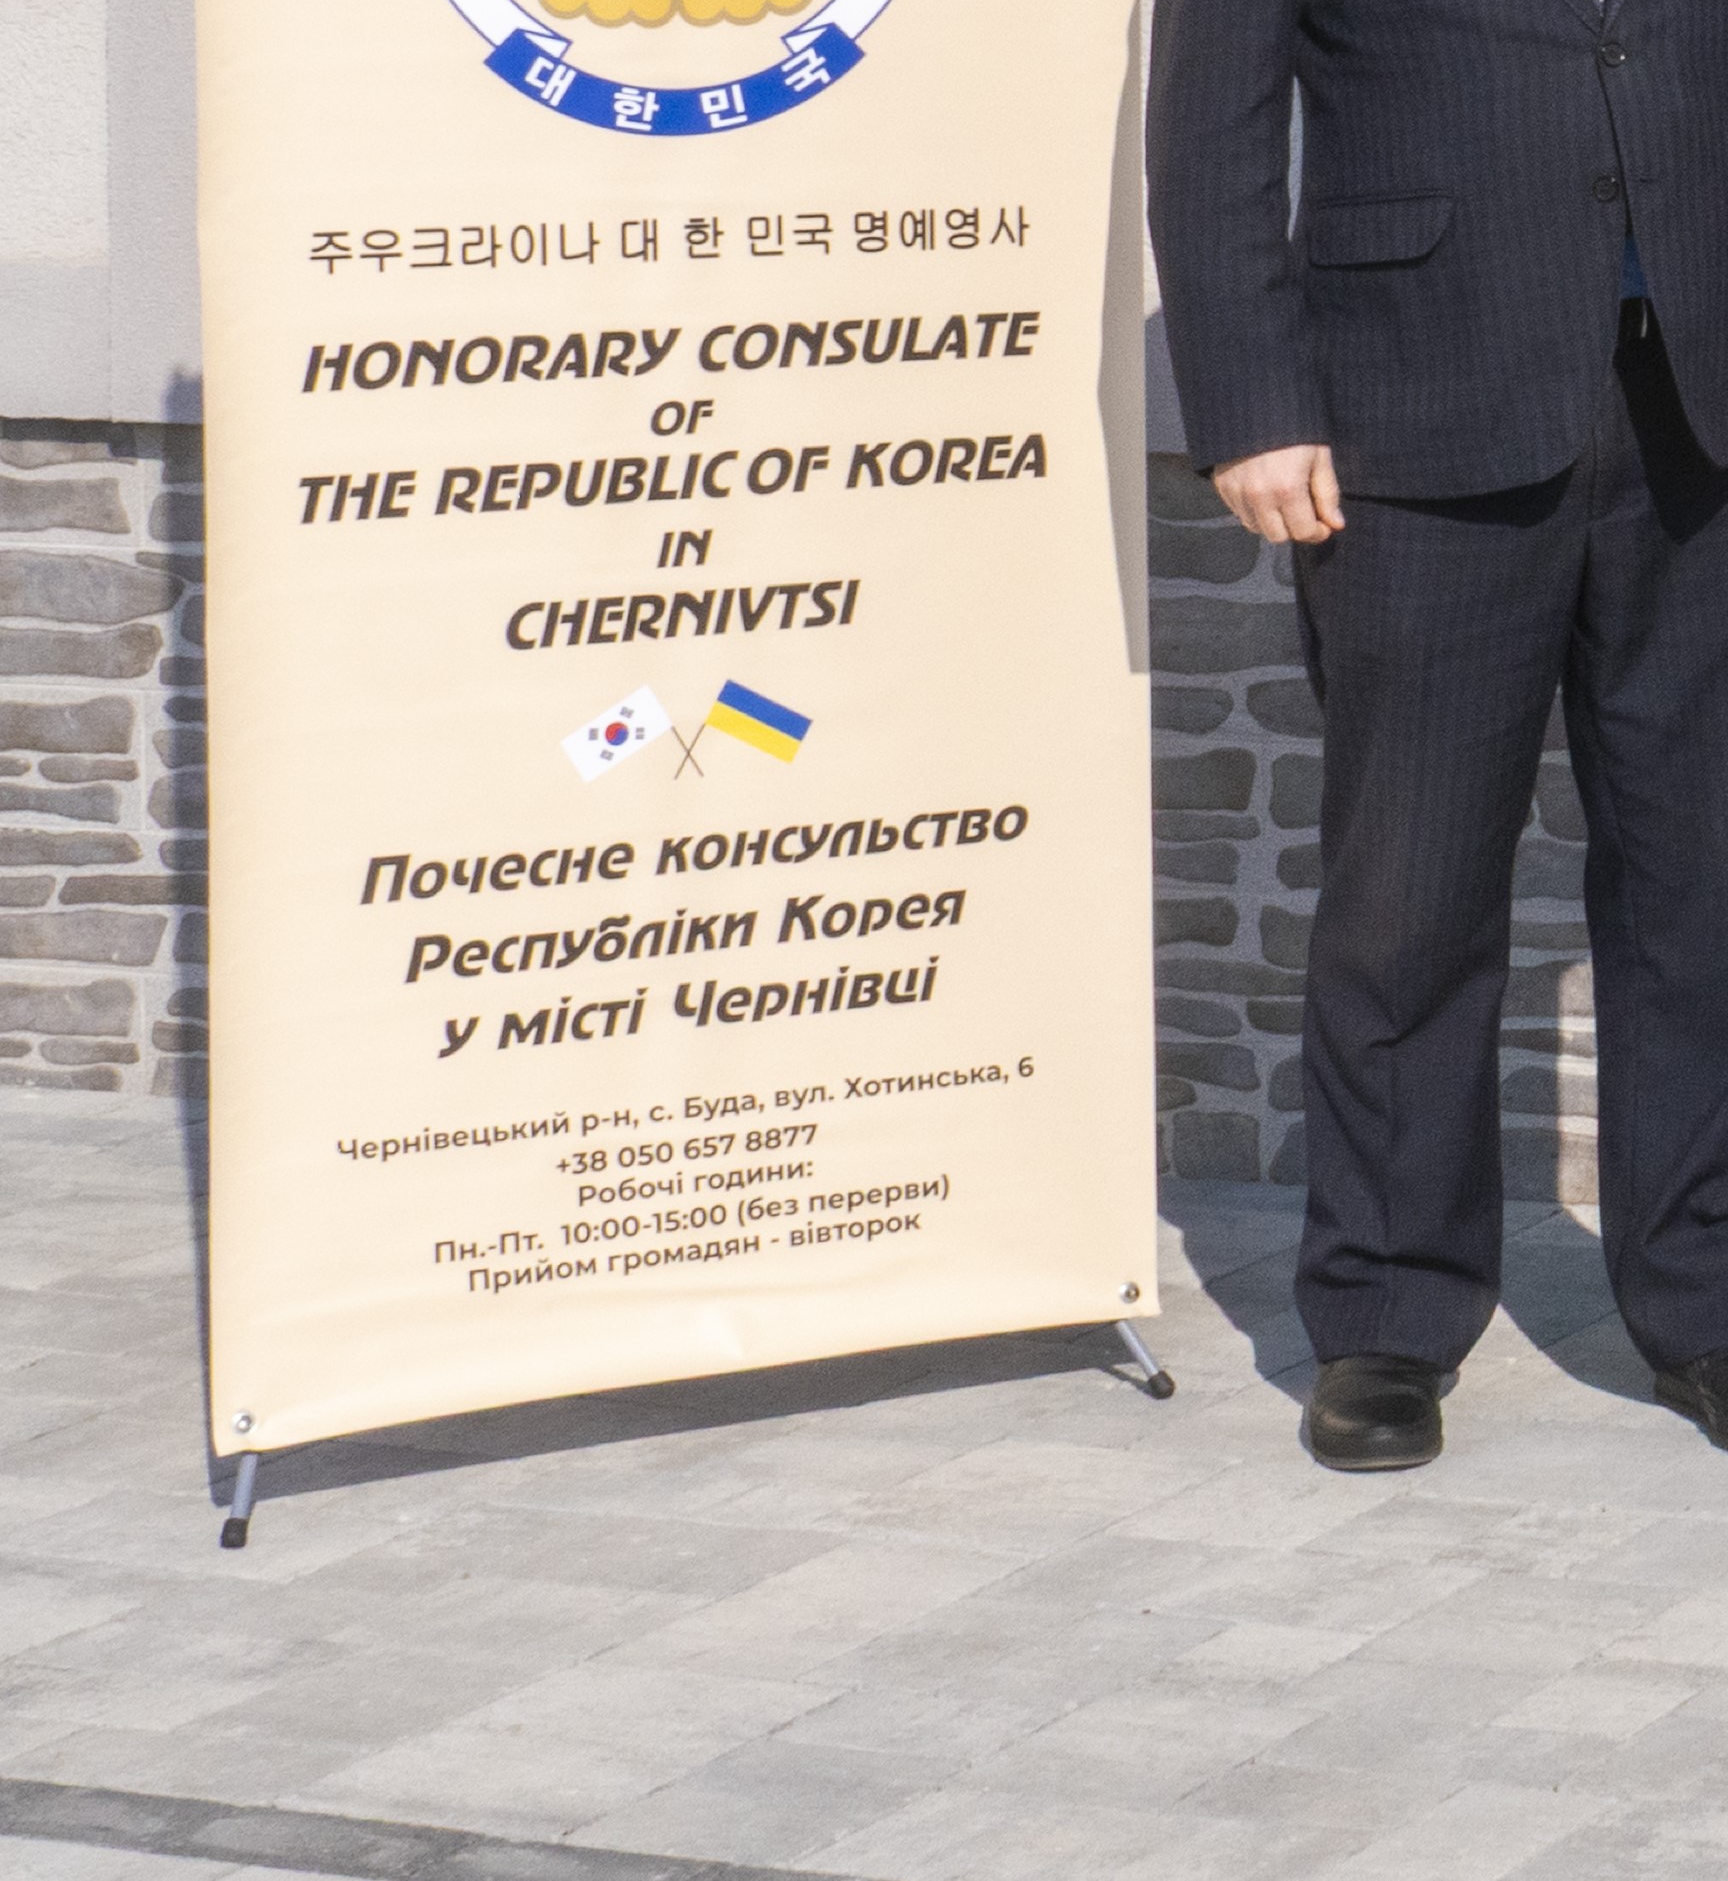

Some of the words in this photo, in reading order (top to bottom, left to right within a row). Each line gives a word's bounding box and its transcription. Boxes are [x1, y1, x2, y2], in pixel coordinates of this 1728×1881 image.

[309, 221, 600, 275] 주우크라이나
[854, 206, 1030, 254] 명예영사
[302, 328, 682, 393] HONORARY
[698, 311, 1040, 373] CONSULATE
[650, 399, 714, 437] OF
[299, 470, 416, 525] THE
[434, 450, 739, 516] REPUBLIC
[746, 445, 830, 496] OF
[846, 433, 1047, 489] KOREA
[657, 529, 713, 569] IN
[505, 579, 860, 651] CHERNIVTSI
[360, 842, 635, 905] Почесне
[655, 805, 1029, 876] консульство
[405, 908, 758, 984] Республіки
[777, 889, 966, 944] Корея
[438, 1016, 479, 1059] у
[497, 987, 647, 1050] місті
[673, 955, 939, 1027] Чернівці
[337, 1112, 571, 1162] Чернівецький
[581, 1108, 640, 1137] р-н,
[649, 1104, 673, 1122] с.
[684, 1094, 765, 1122] Буда,
[775, 1084, 834, 1109] вул.
[845, 1065, 1009, 1099] Хотинська,
[1018, 1056, 1034, 1078] 6
[557, 1150, 608, 1175] +38
[617, 1142, 674, 1168] 050
[683, 1133, 735, 1160] 657
[745, 1124, 817, 1152] 8877
[578, 1171, 684, 1206] Робочі
[694, 1159, 814, 1192] години:
[435, 1231, 543, 1263] Пн.-Пт.
[561, 1204, 727, 1245] 10:00-15:00
[737, 1197, 798, 1227] (без
[807, 1172, 949, 1213] перерви)
[469, 1256, 597, 1293] Прийом
[608, 1236, 760, 1275] громадян
[790, 1214, 920, 1247] вівторок
